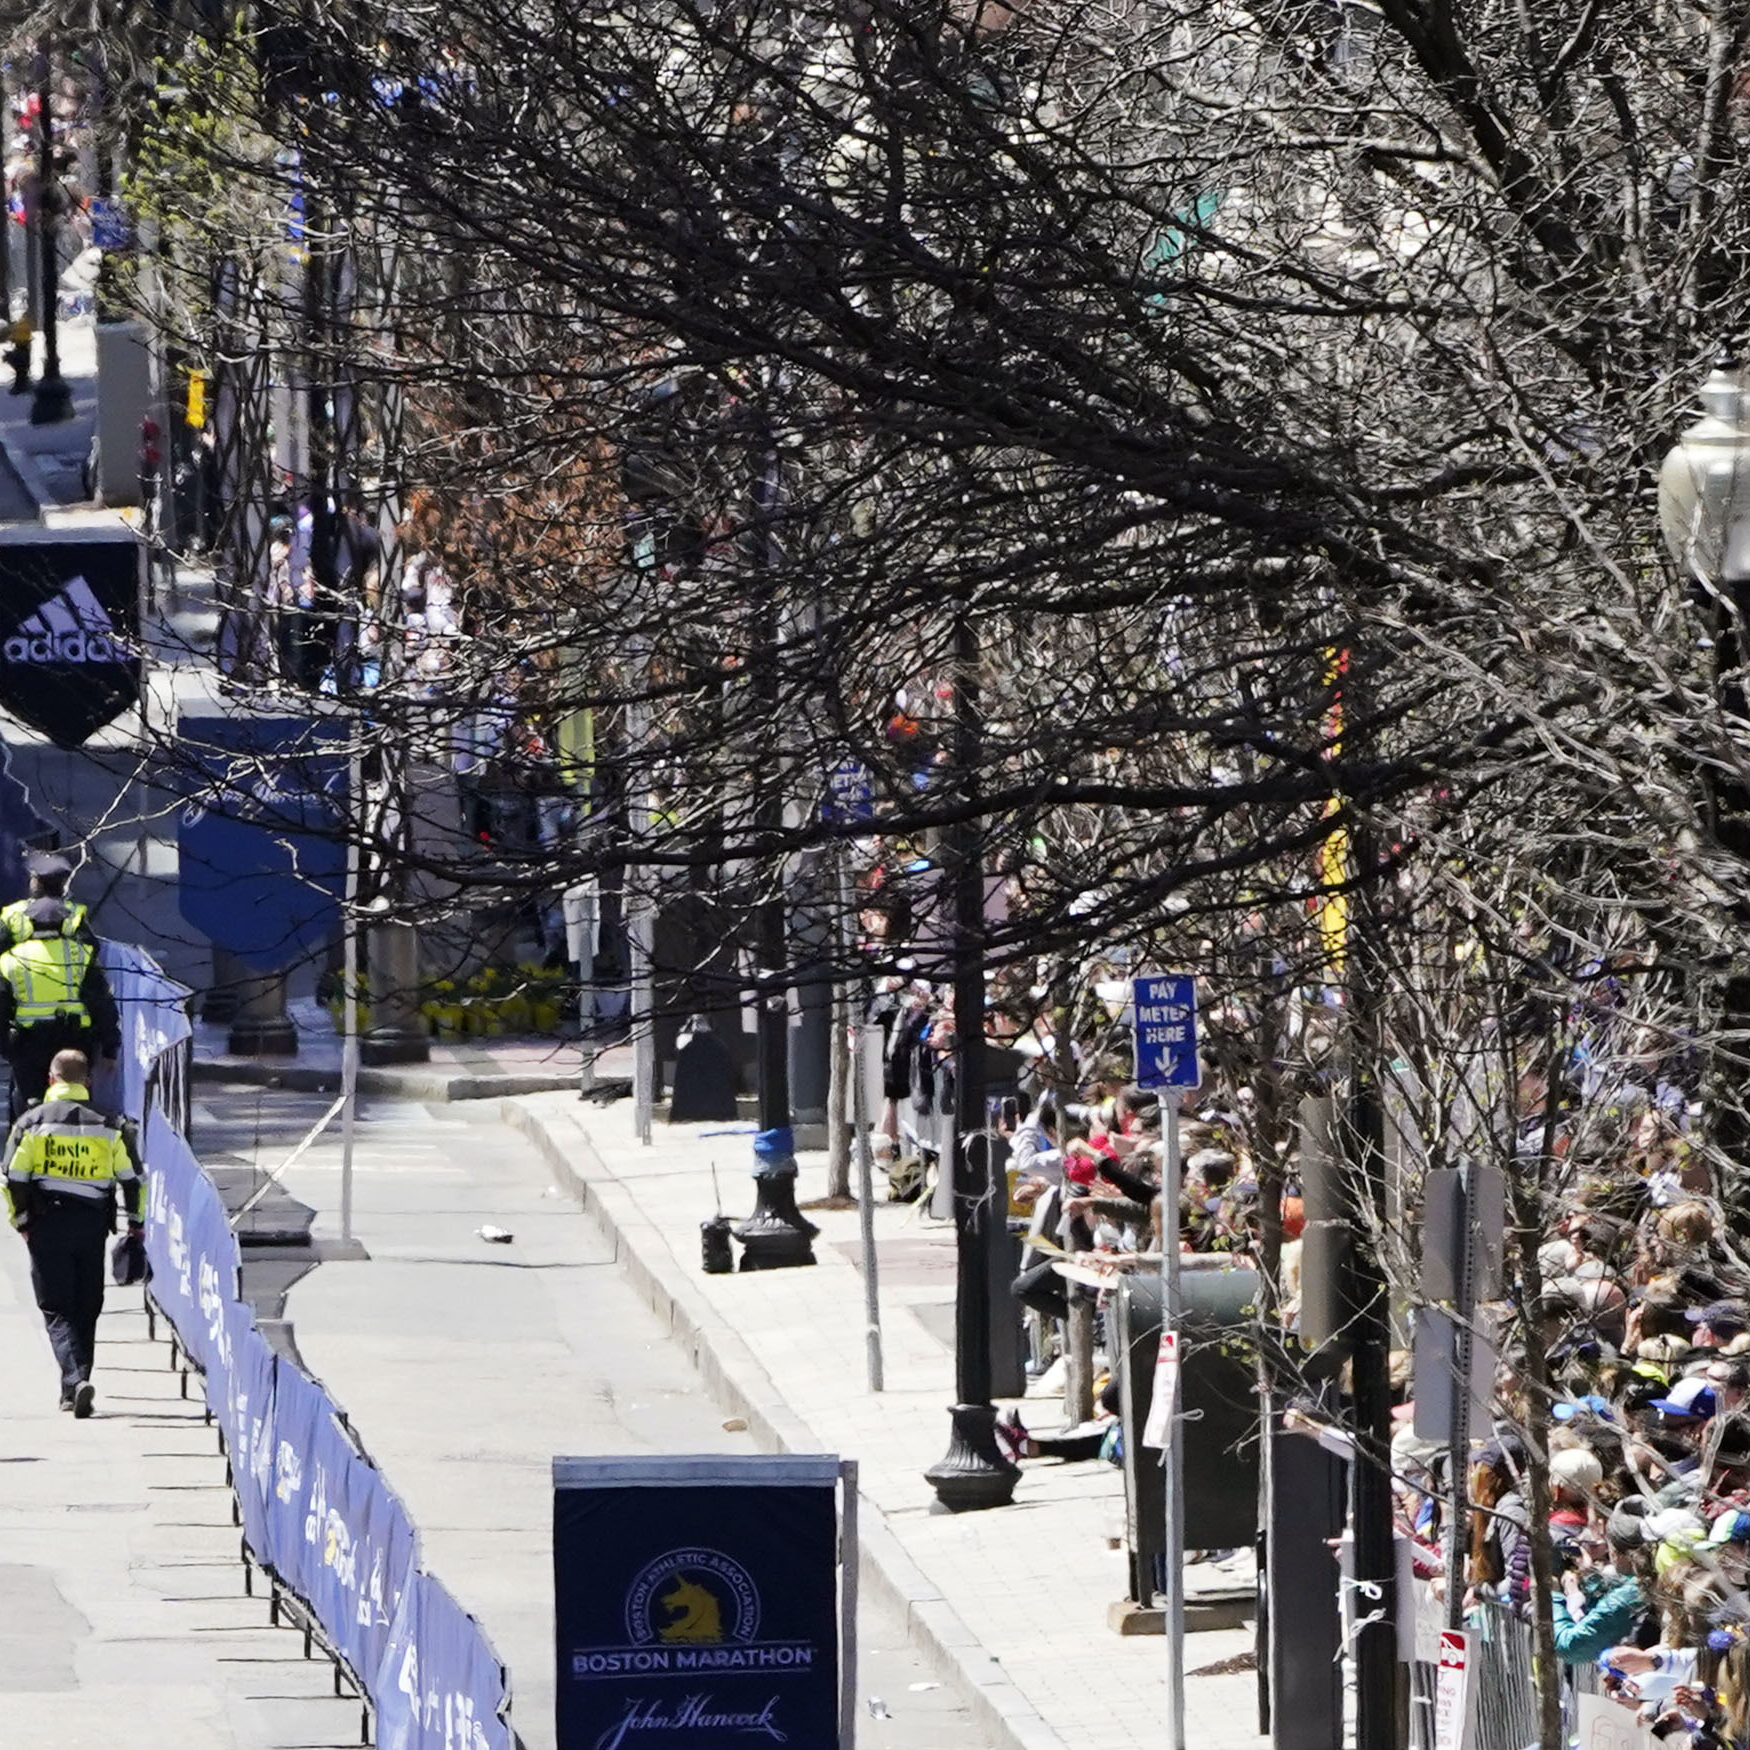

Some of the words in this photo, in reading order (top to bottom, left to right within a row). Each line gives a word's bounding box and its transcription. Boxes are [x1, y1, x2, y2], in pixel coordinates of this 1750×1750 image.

[4, 632, 120, 662] adida
[1150, 982, 1176, 1000] PAY
[1139, 1005, 1190, 1023] METER
[1146, 1026, 1185, 1044] HERE
[573, 1652, 670, 1673] BOSTON
[676, 1648, 813, 1671] MARATHON
[674, 1694, 788, 1742] Hancock
